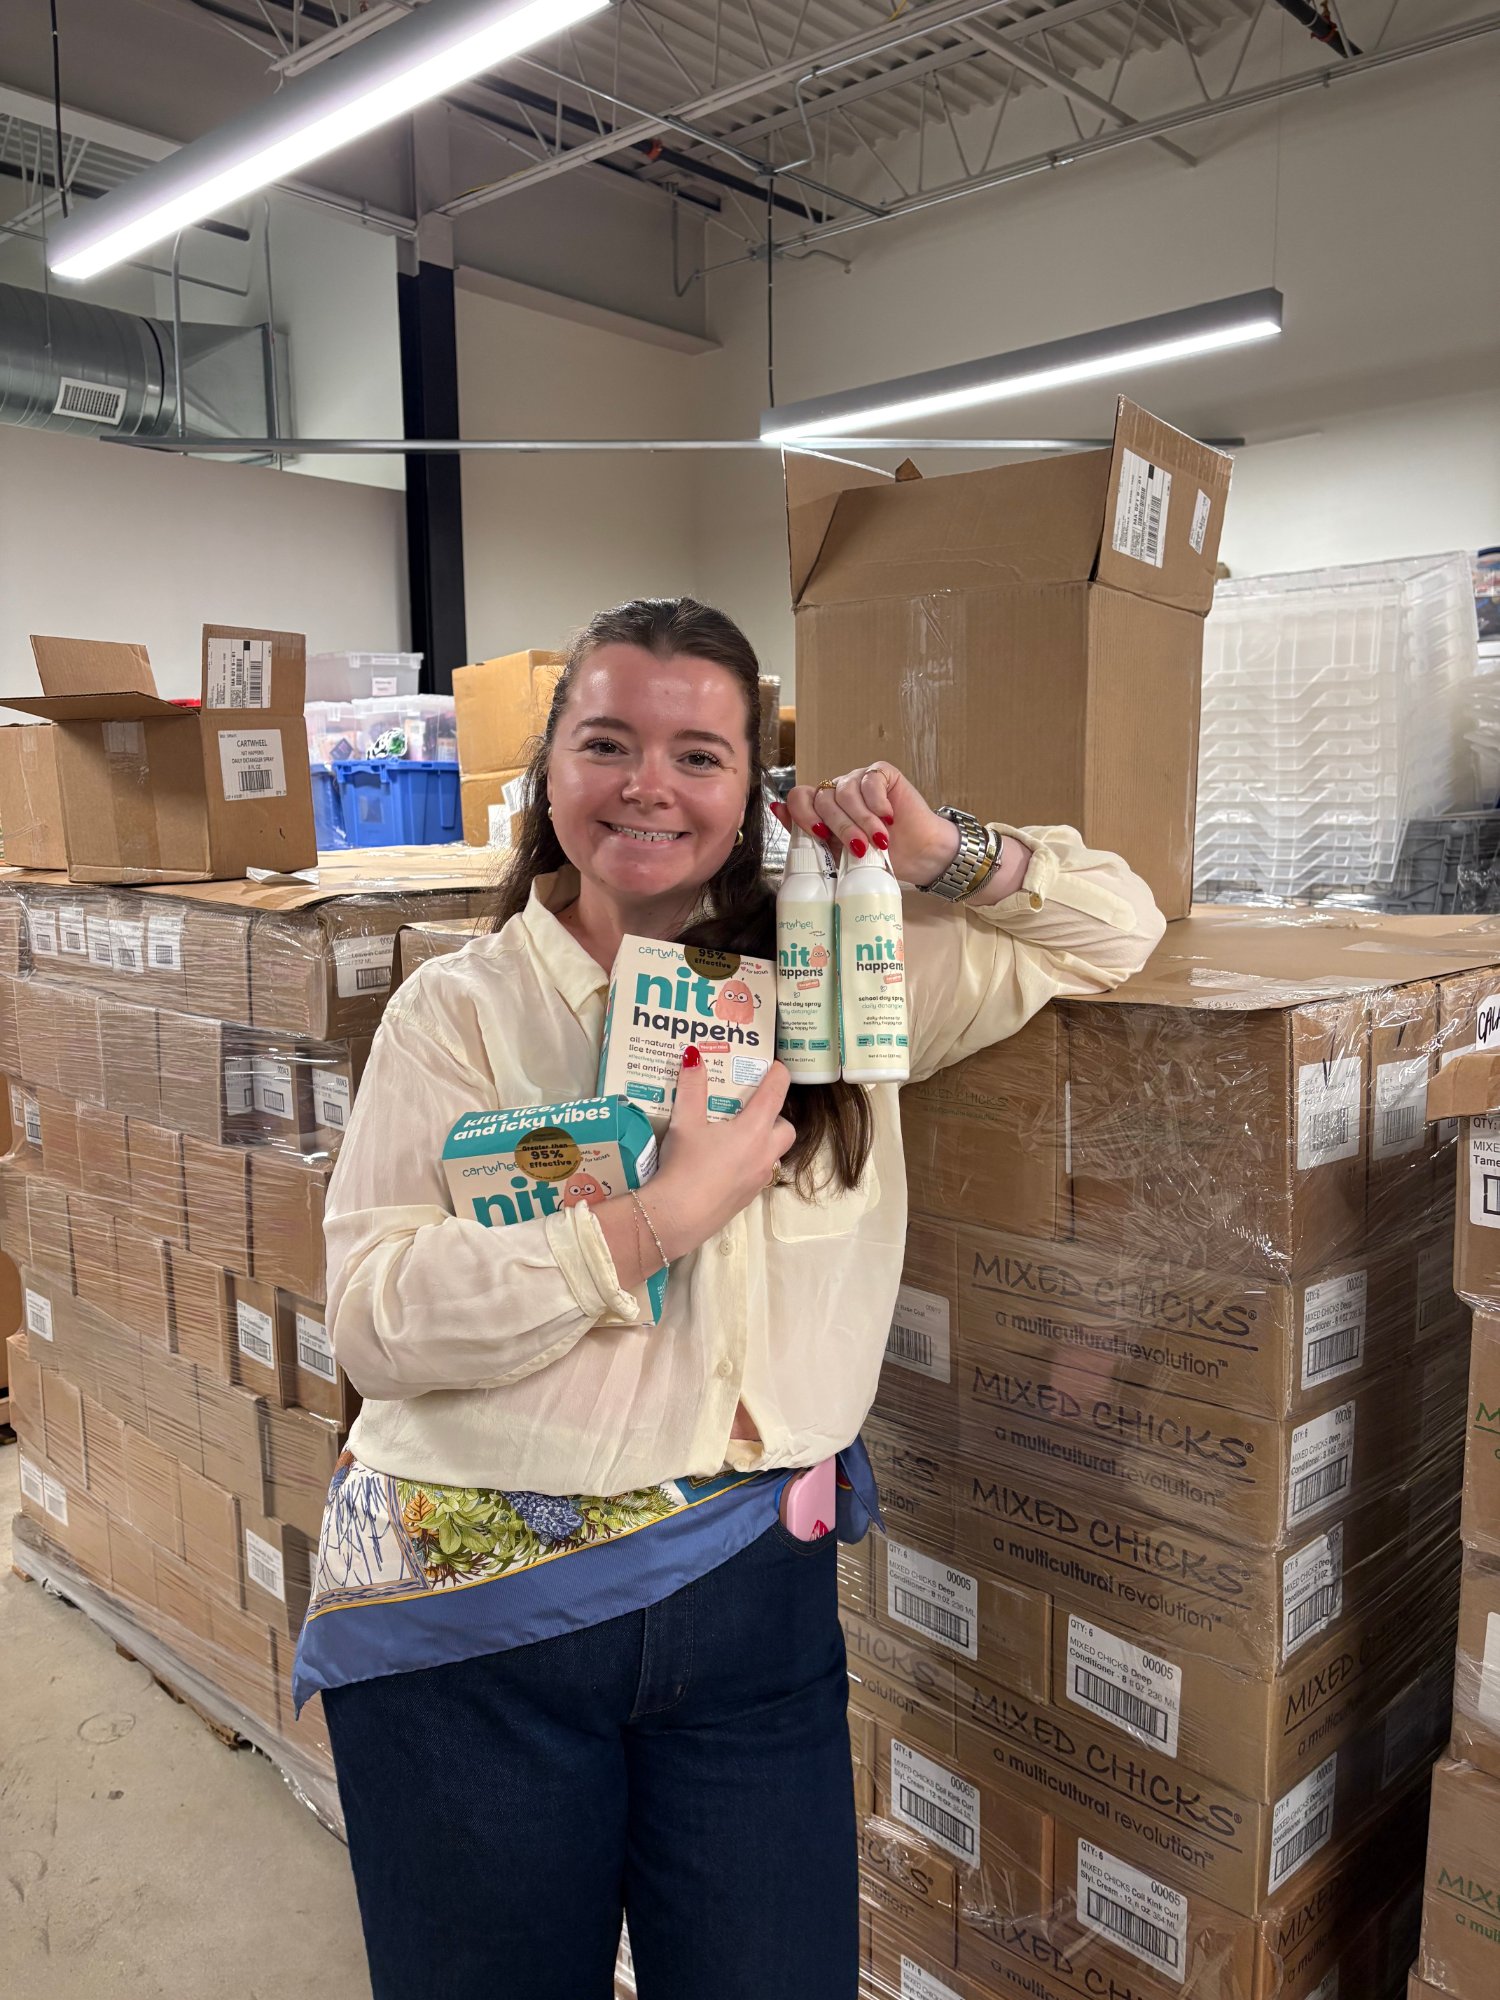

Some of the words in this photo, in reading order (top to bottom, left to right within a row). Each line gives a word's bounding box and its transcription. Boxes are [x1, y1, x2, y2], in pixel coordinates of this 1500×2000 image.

[237, 740, 268, 748] CARTWHEEL
[778, 918, 813, 930] artwheel
[855, 912, 896, 922] cartwheel
[638, 946, 684, 960] cartwhe
[699, 948, 726, 960] 95%
[779, 943, 810, 968] nit
[856, 936, 895, 961] nit
[694, 958, 731, 969] Effective
[856, 962, 903, 973] happens
[634, 966, 716, 1017] nit
[633, 1006, 760, 1046] happens
[629, 1044, 644, 1052] lice
[646, 1048, 684, 1060] treatmen
[630, 1036, 675, 1049] all-natural
[627, 1062, 640, 1070] gel
[642, 1065, 679, 1076] antipiojo
[454, 1125, 497, 1140] and
[500, 1115, 546, 1131] icky
[550, 1105, 611, 1126] vibes
[464, 1112, 509, 1128] kills
[512, 1104, 556, 1118] lice,
[1473, 1117, 1497, 1130] QTY:
[522, 1144, 550, 1152] Greater
[531, 1149, 565, 1160] 95%
[462, 1161, 519, 1178] cartwhee
[529, 1159, 572, 1169] Effective
[472, 1176, 560, 1228] nit
[972, 1252, 1084, 1297] MIXED
[995, 1311, 1006, 1326] a
[1012, 1314, 1118, 1355] multicultural
[1305, 1321, 1332, 1335] Conditioner
[972, 1366, 1082, 1418] MIXED
[994, 1426, 1006, 1440] a
[1010, 1428, 1116, 1474] multicultural
[1292, 1448, 1308, 1463] MIXED
[1309, 1438, 1328, 1455] CHICKS
[1328, 1433, 1341, 1445] Deep
[1291, 1456, 1319, 1476] Conditioner
[972, 1478, 1079, 1534] MIXED
[889, 1544, 903, 1558] QTY:
[947, 1570, 971, 1591] 00005
[889, 1560, 910, 1574] MIXED
[911, 1570, 937, 1588] CHICKS
[938, 1584, 955, 1597] Deep
[993, 1538, 1004, 1552] a
[1008, 1541, 1114, 1592] multicultural
[1284, 1580, 1300, 1594] MIXED
[1300, 1563, 1318, 1583] CHICKS
[890, 1570, 926, 1593] Conditioner
[1284, 1582, 1311, 1607] Conditioner
[1070, 1636, 1095, 1655] MIXED
[1097, 1651, 1128, 1673] CHICKS
[1131, 1668, 1152, 1685] Deep
[1071, 1619, 1087, 1634] QTY:
[1142, 1655, 1173, 1680] 00005
[1070, 1648, 1115, 1677] Conditioner
[1122, 1675, 1127, 1683] 8
[1286, 1653, 1354, 1725] MIXED
[972, 1687, 1076, 1755] MIXED
[894, 1742, 908, 1757] QTY:
[951, 1776, 975, 1799] 00065
[894, 1758, 912, 1774] MIXED
[913, 1769, 934, 1788] CHICKS
[962, 1799, 974, 1812] Curl
[906, 1776, 925, 1792] Cream
[993, 1748, 1004, 1762] a
[1009, 1755, 1110, 1818] multicultural
[1081, 1841, 1097, 1857] QTY:
[1098, 1851, 1103, 1860] 6
[1151, 1880, 1181, 1907] 00065
[1080, 1859, 1103, 1877] MIXED
[1104, 1872, 1131, 1893] CHICKS
[1132, 1887, 1146, 1902] Coil
[1147, 1896, 1163, 1912] Kink
[1164, 1906, 1179, 1921] Curl
[1097, 1879, 1119, 1897] Cream
[1124, 1895, 1132, 1907] 12
[1438, 1866, 1500, 1912] MIX
[1456, 1913, 1466, 1925] a
[991, 1959, 1001, 1972] a
